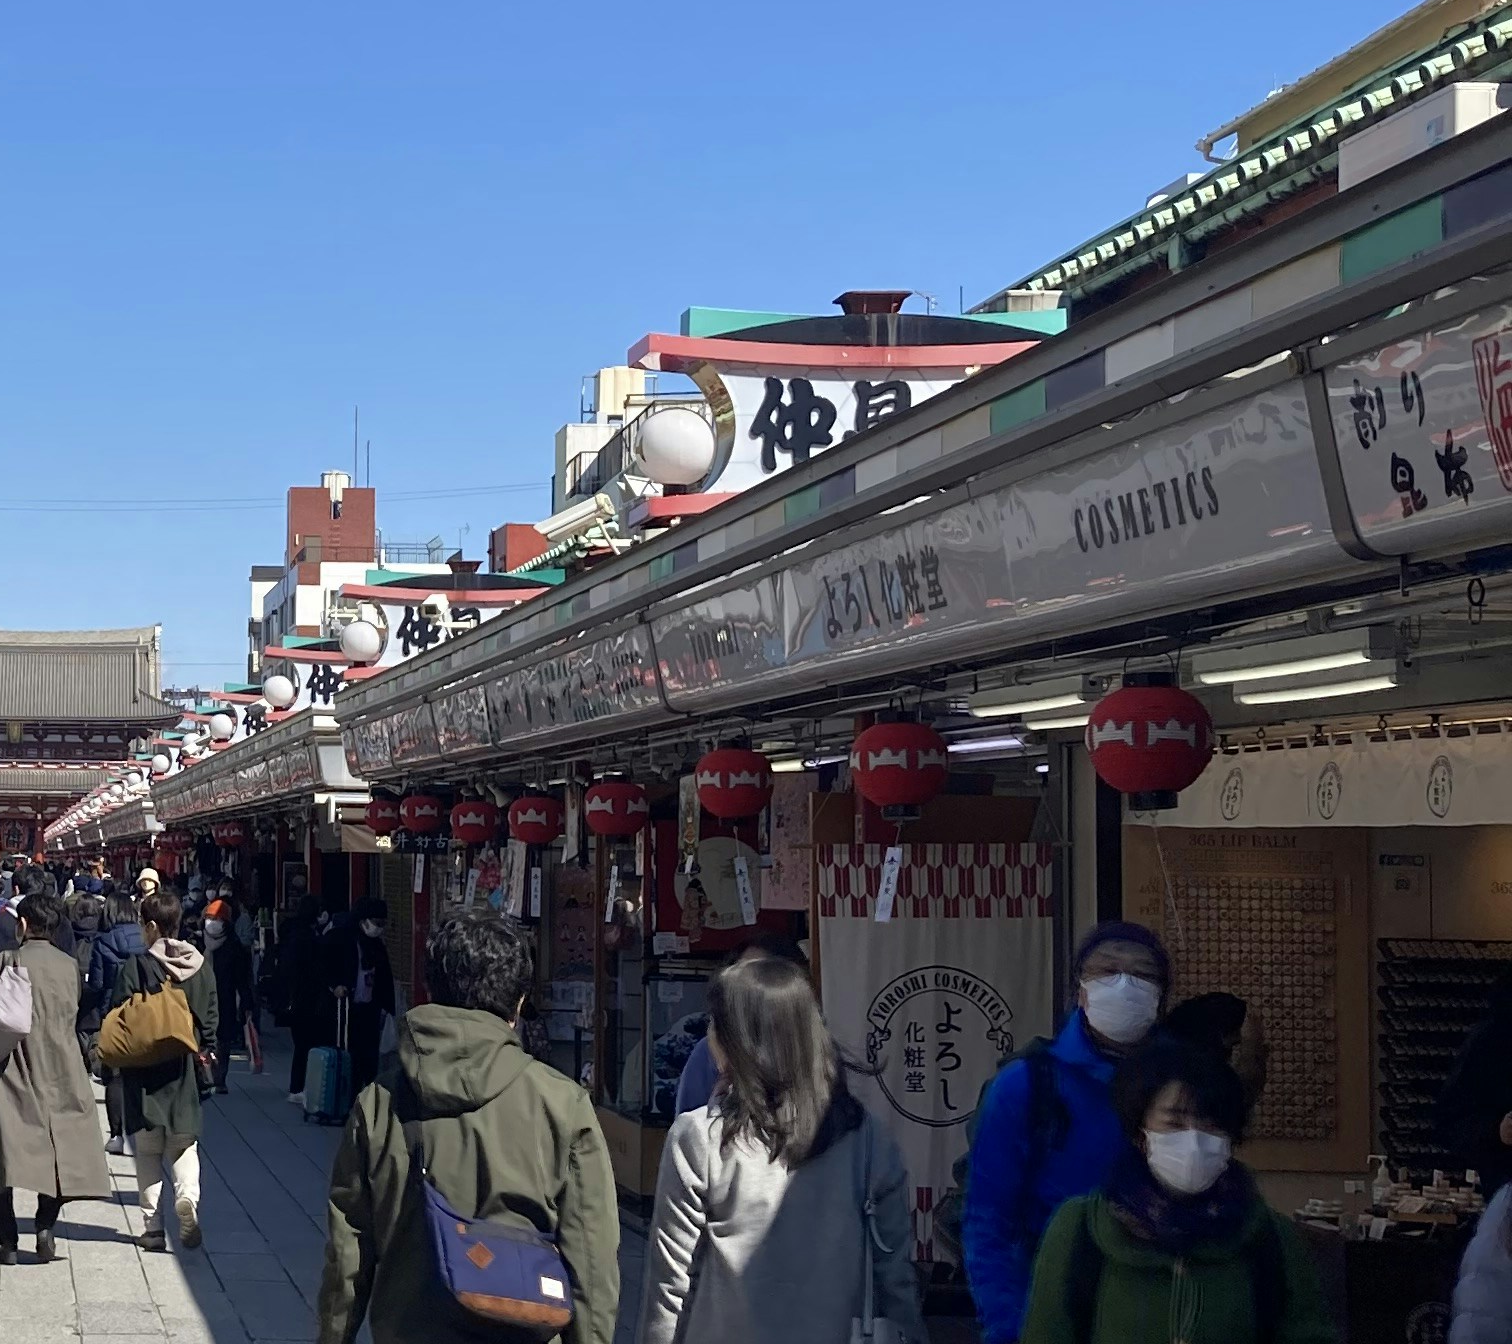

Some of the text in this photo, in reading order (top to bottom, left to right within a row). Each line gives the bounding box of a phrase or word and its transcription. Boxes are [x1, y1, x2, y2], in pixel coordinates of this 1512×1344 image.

[1349, 370, 1426, 450] 削り
[1074, 465, 1219, 553] COSMETICS
[1391, 428, 1474, 519] 昆布
[824, 545, 948, 640] よろし化粧堂
[1252, 834, 1297, 849] BALM
[872, 971, 1006, 1022] YOROSHI COSMETICS
[904, 1021, 926, 1093] 化粧堂
[935, 1000, 963, 1111] よろし
